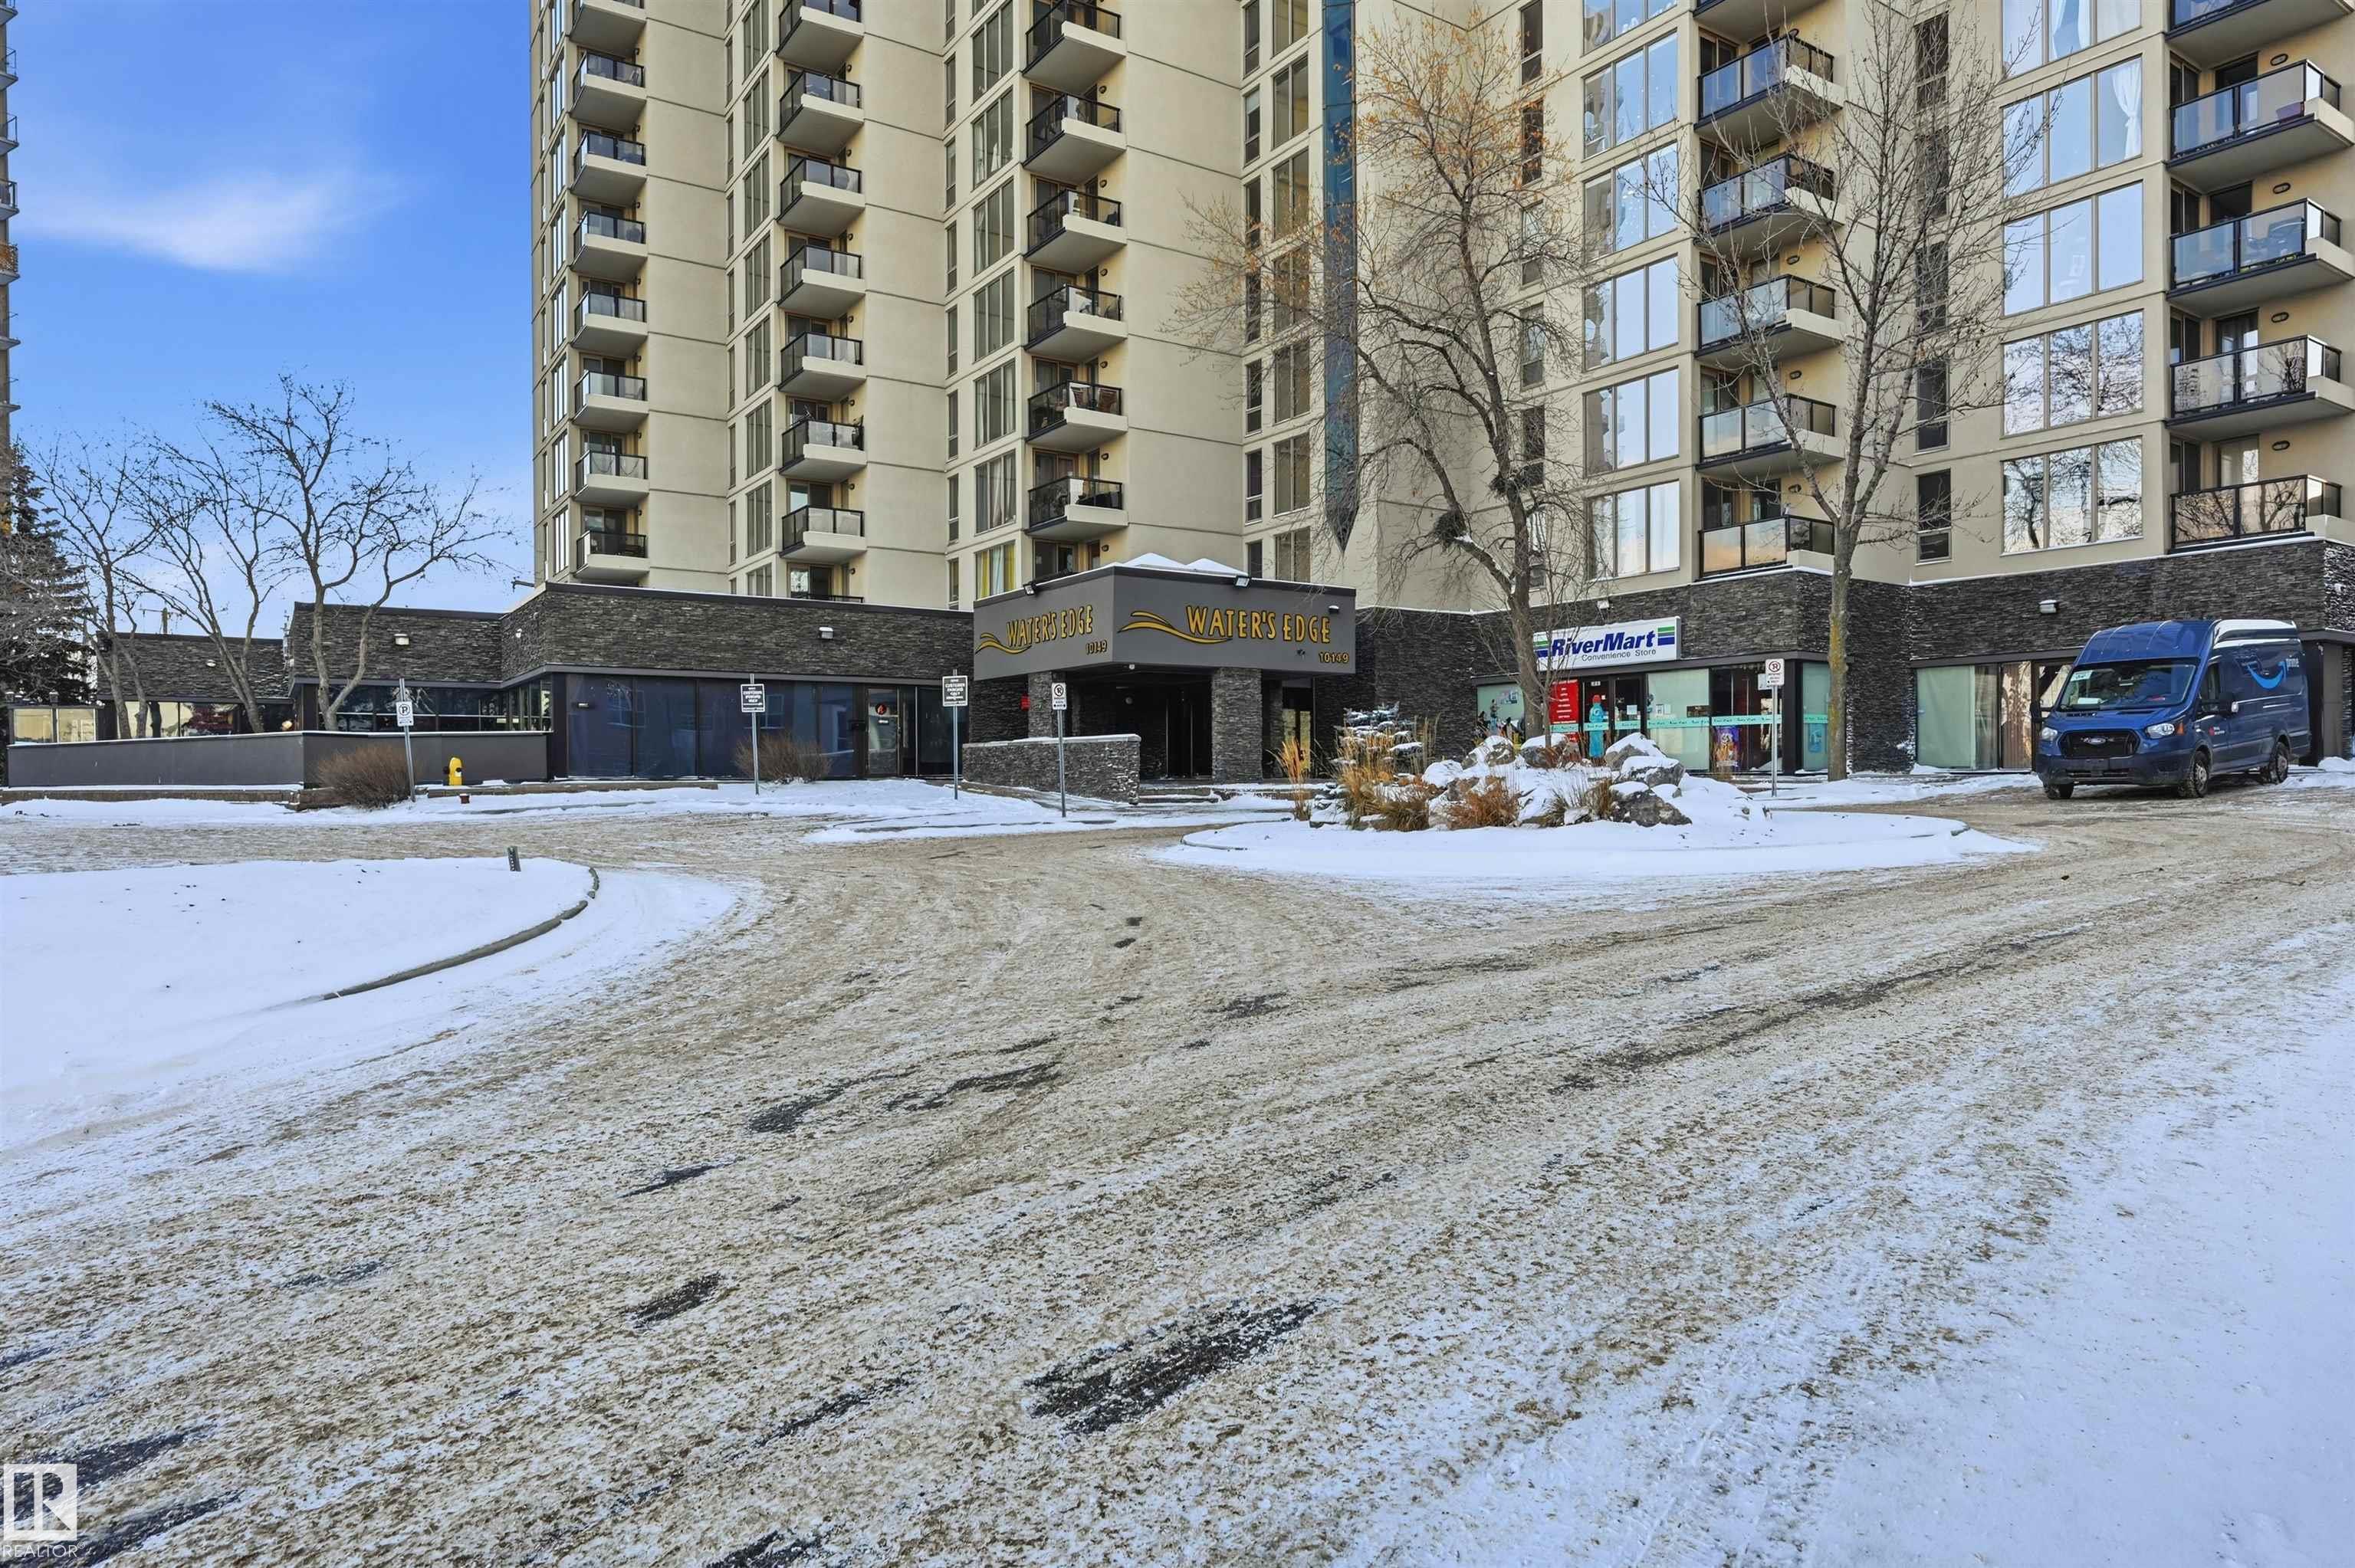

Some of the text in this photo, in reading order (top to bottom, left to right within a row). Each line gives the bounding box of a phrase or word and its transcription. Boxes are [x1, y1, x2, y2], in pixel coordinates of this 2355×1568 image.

[1007, 605, 1092, 647] WATER'S EDGE
[1186, 605, 1331, 644] WATER'S EDGE
[1086, 639, 1108, 654] 10149
[1551, 630, 1656, 658] RiverMart
[1319, 651, 1349, 664] 10149
[1581, 648, 1657, 662] Convenience Store
